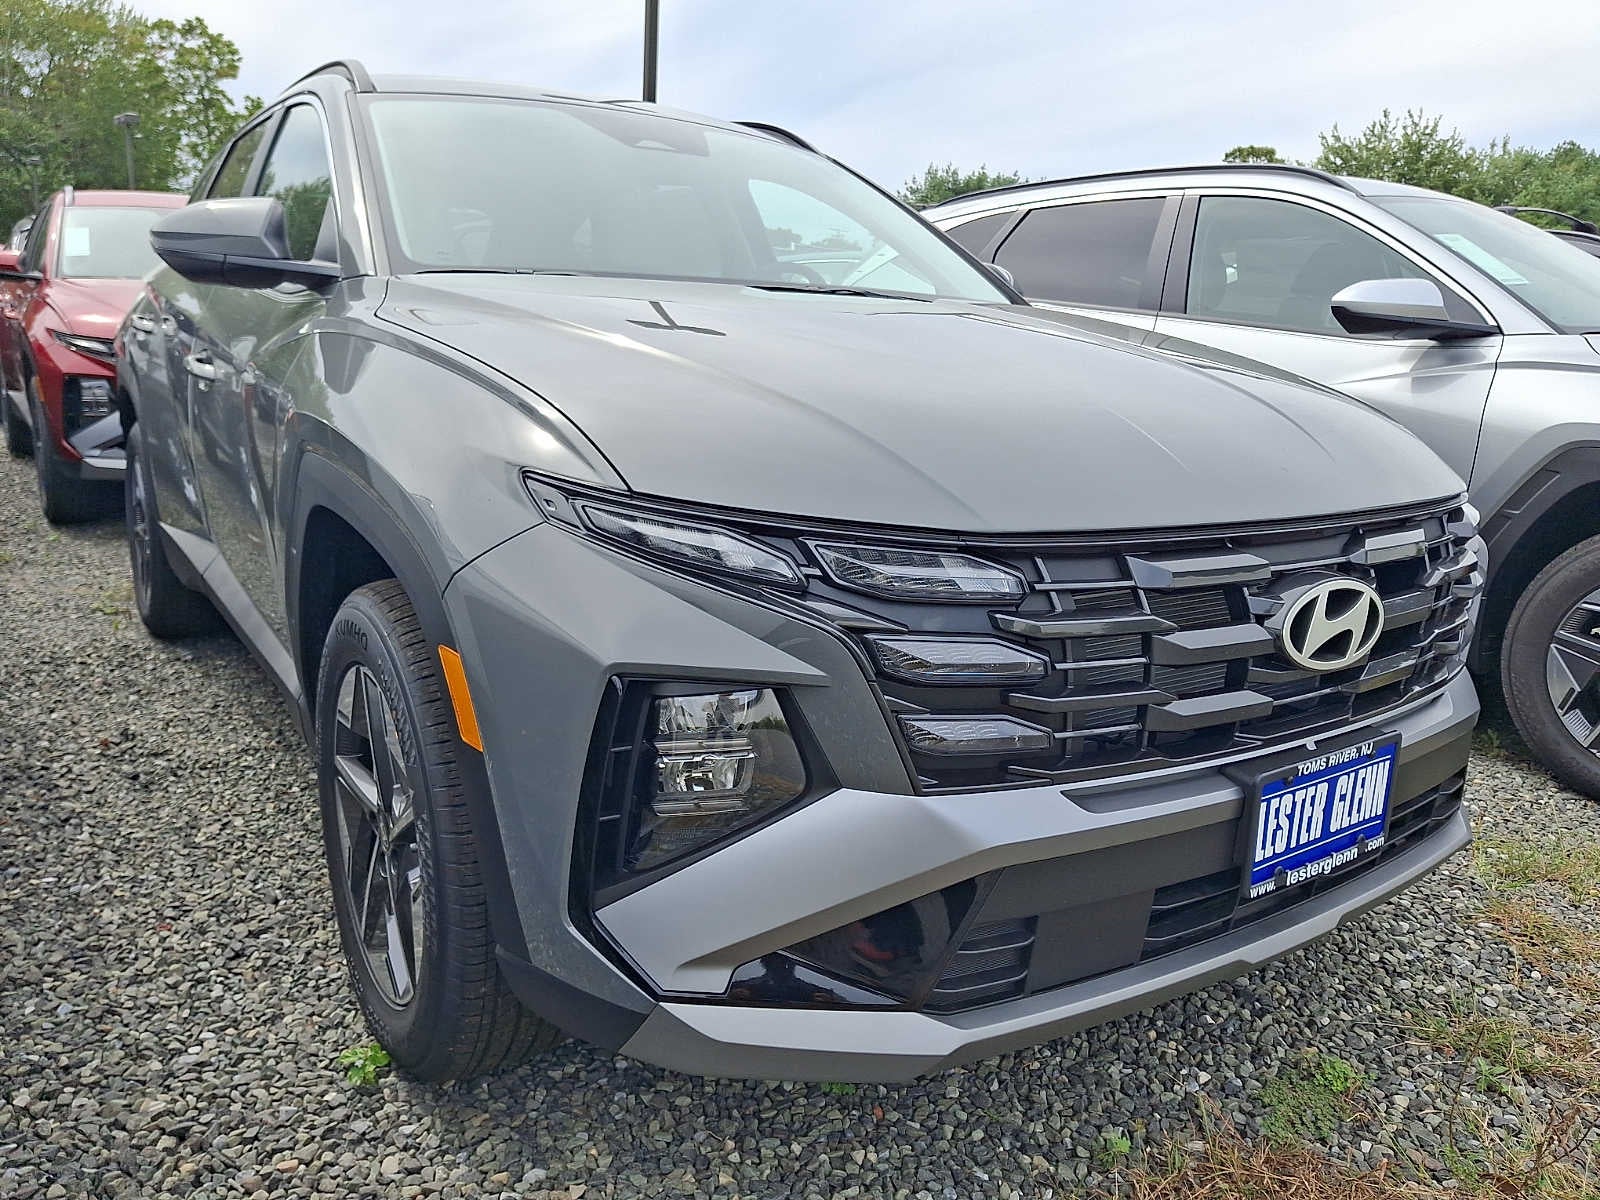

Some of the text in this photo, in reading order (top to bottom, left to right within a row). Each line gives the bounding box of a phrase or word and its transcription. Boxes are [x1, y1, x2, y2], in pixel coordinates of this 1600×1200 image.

[1297, 742, 1374, 777] TOMS RIVER, NJ
[1254, 760, 1390, 863] LESTER GLENN
